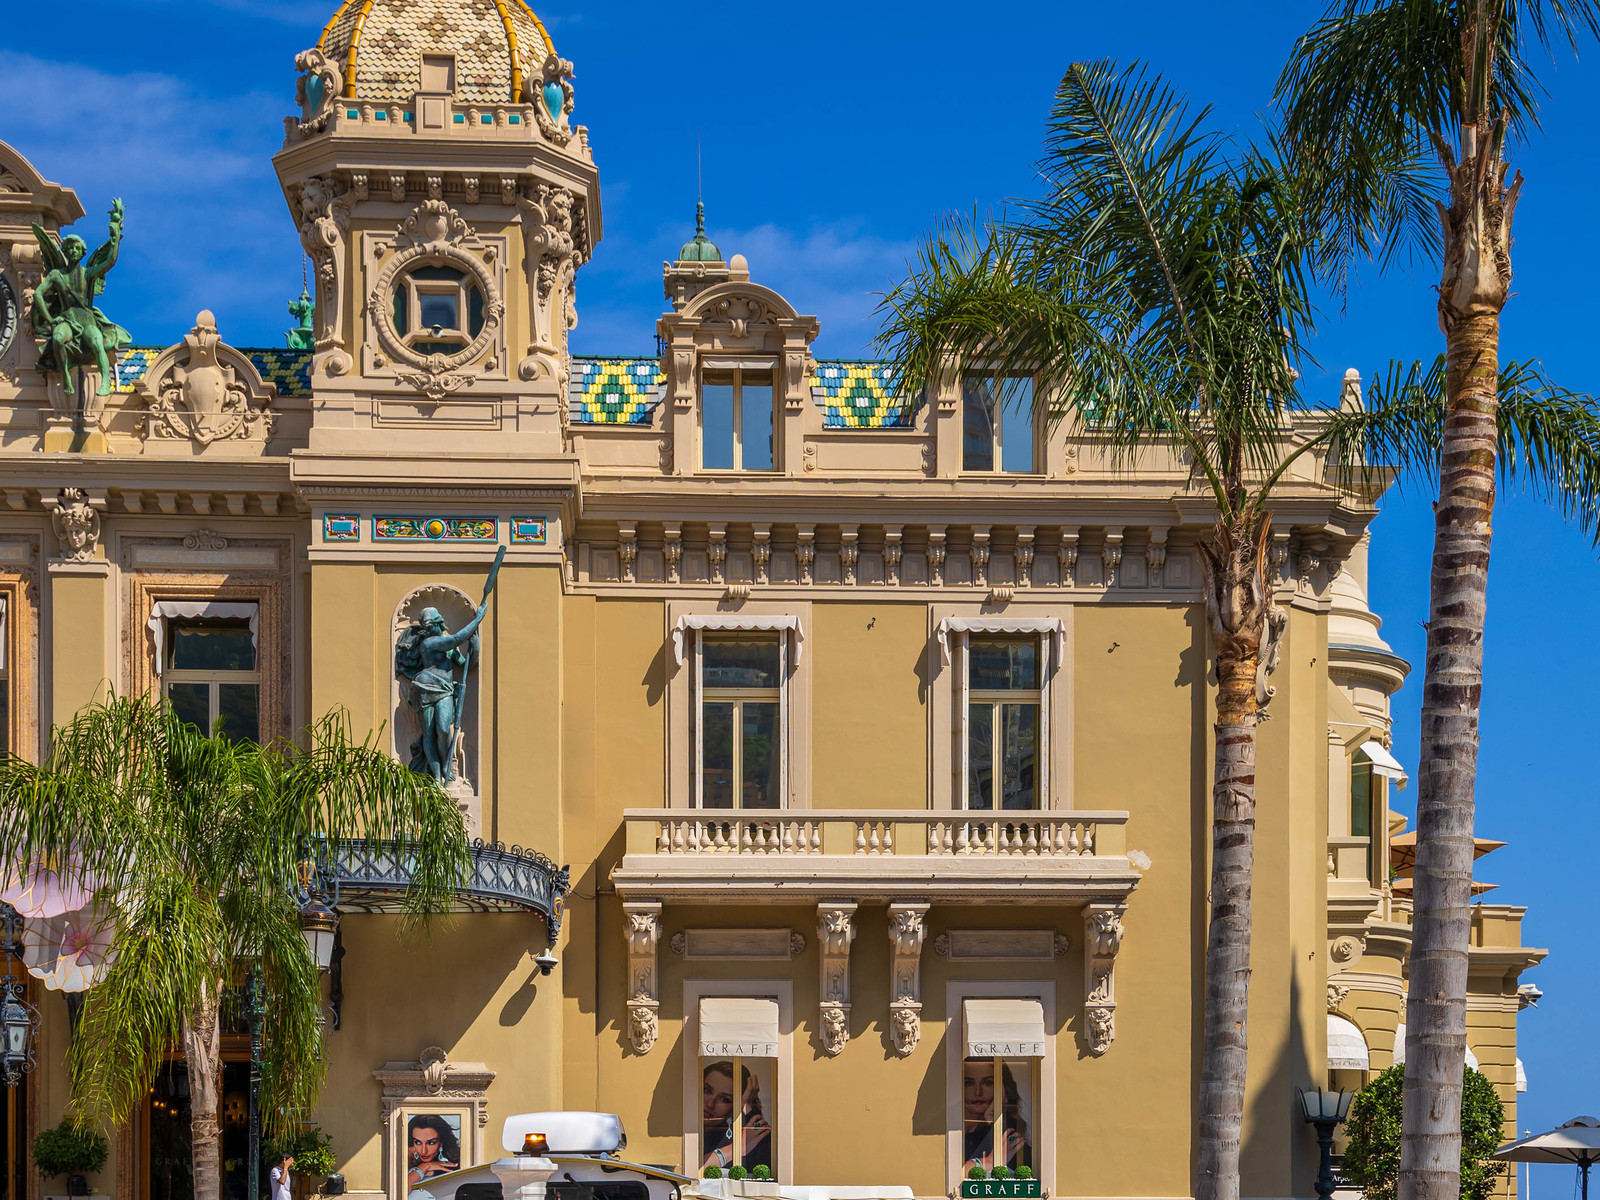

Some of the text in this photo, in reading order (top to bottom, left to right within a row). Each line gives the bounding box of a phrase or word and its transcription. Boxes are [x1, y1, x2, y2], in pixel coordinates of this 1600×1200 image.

[705, 1043, 772, 1054] GRAFF
[974, 1043, 1040, 1054] GRAFF
[155, 1157, 189, 1166] GRAF
[969, 1184, 1035, 1195] GRAFF
